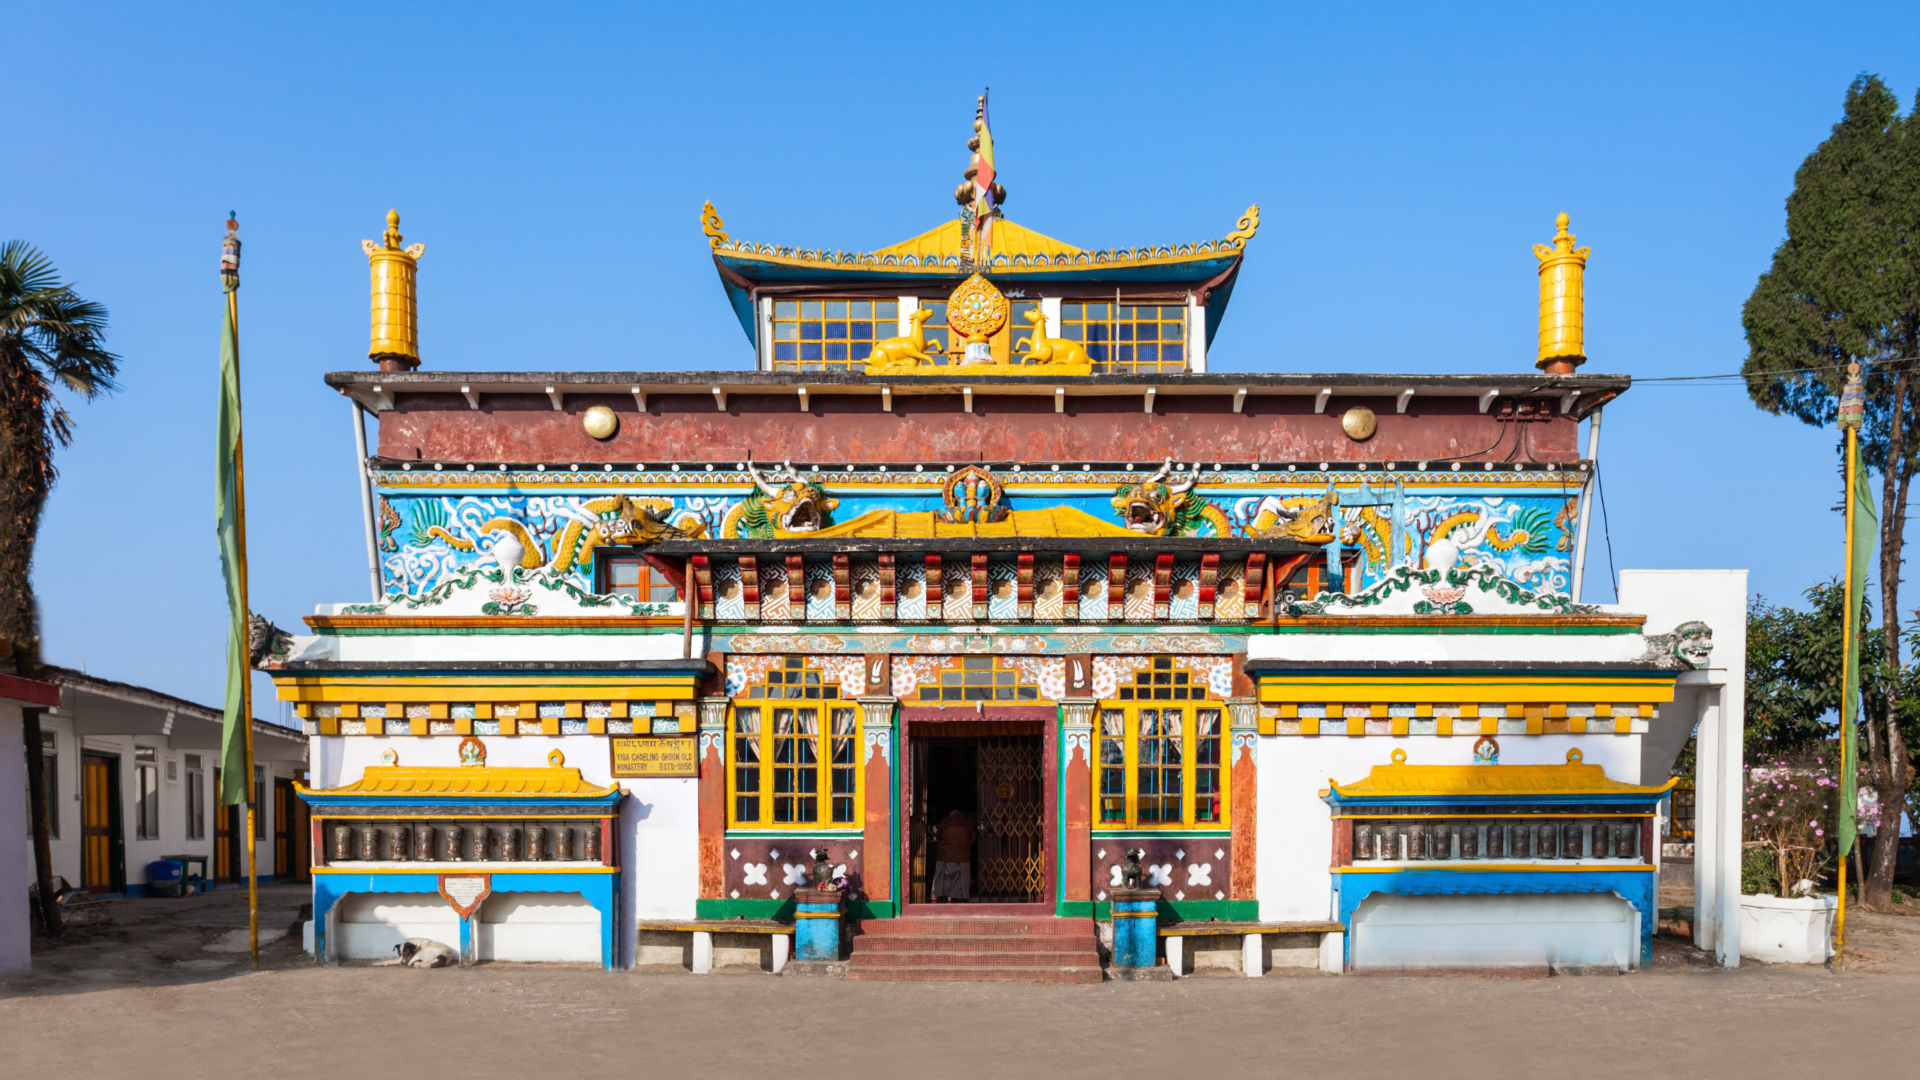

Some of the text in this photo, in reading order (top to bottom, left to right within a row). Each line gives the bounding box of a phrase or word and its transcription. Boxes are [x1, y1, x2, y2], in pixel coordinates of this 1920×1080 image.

[616, 753, 692, 761] YIGA CHOELING GHOOM OLD
[616, 763, 647, 771] MONASTERY
